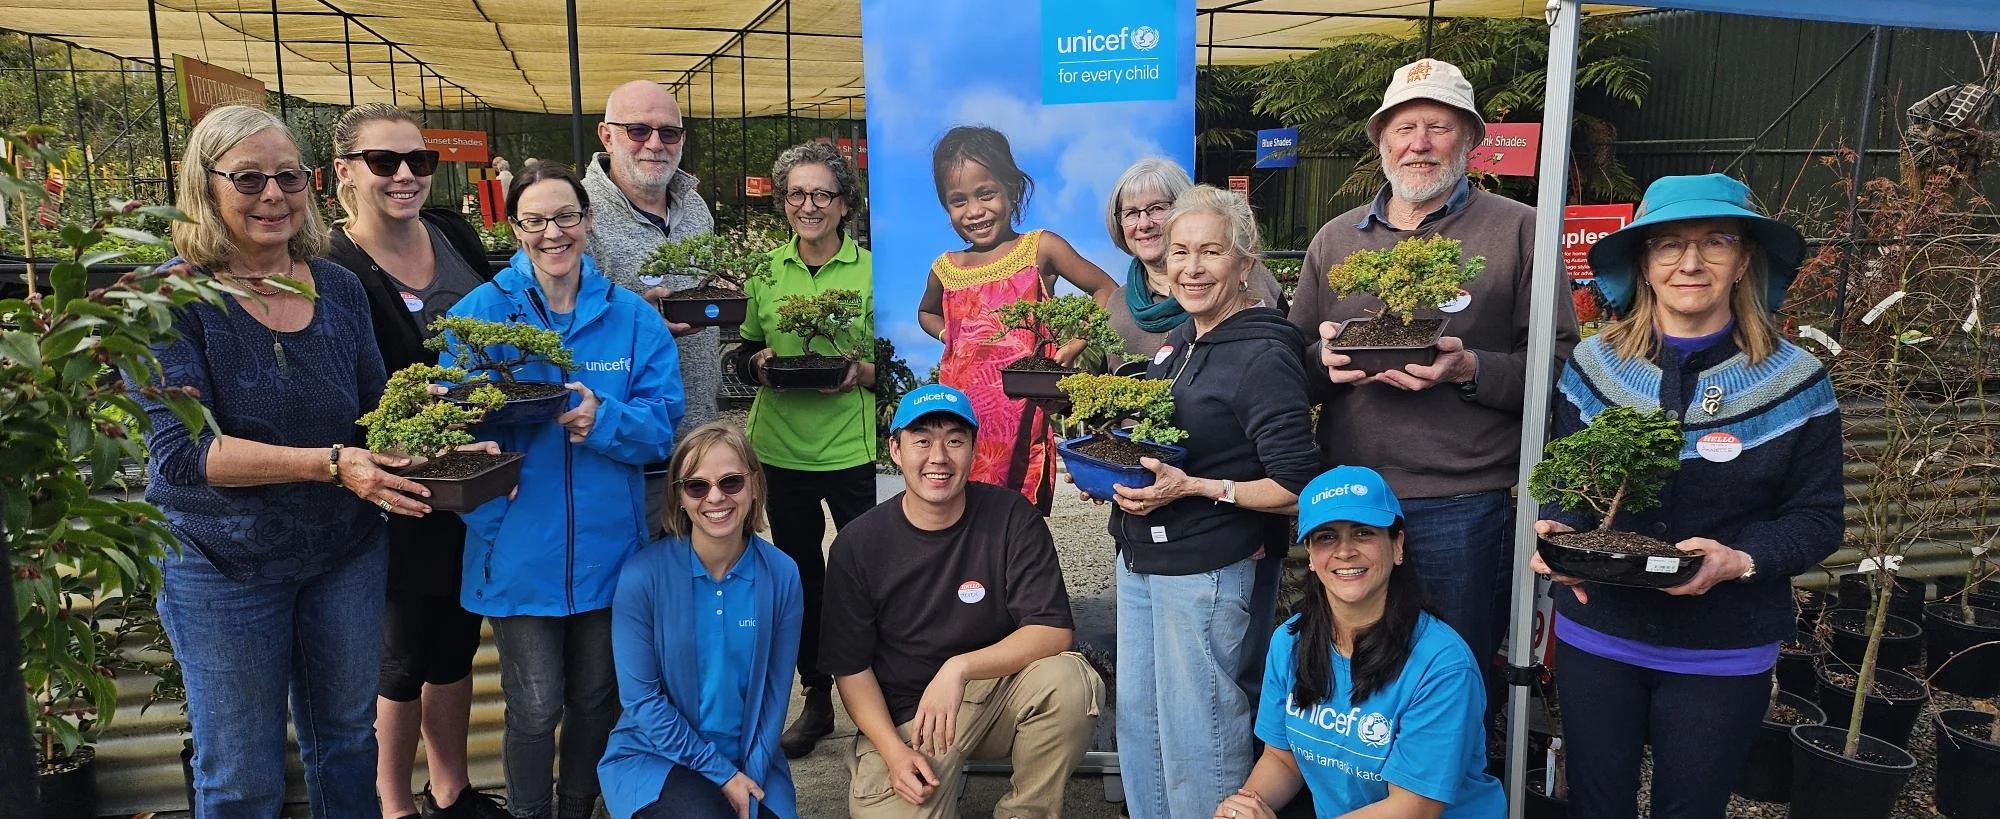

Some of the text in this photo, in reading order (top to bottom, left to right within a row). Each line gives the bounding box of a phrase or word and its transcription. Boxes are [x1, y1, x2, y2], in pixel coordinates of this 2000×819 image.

[1057, 26, 1129, 54] unicef
[1058, 64, 1159, 85] for every child
[423, 136, 483, 146] Sunset Shades
[1261, 137, 1292, 148] Blue Shades
[1494, 135, 1527, 147] Shades
[585, 357, 625, 371] unicef
[913, 392, 945, 405] unicef
[1311, 483, 1350, 505] unicef
[738, 617, 757, 627] unic
[1356, 766, 1383, 782] kato
